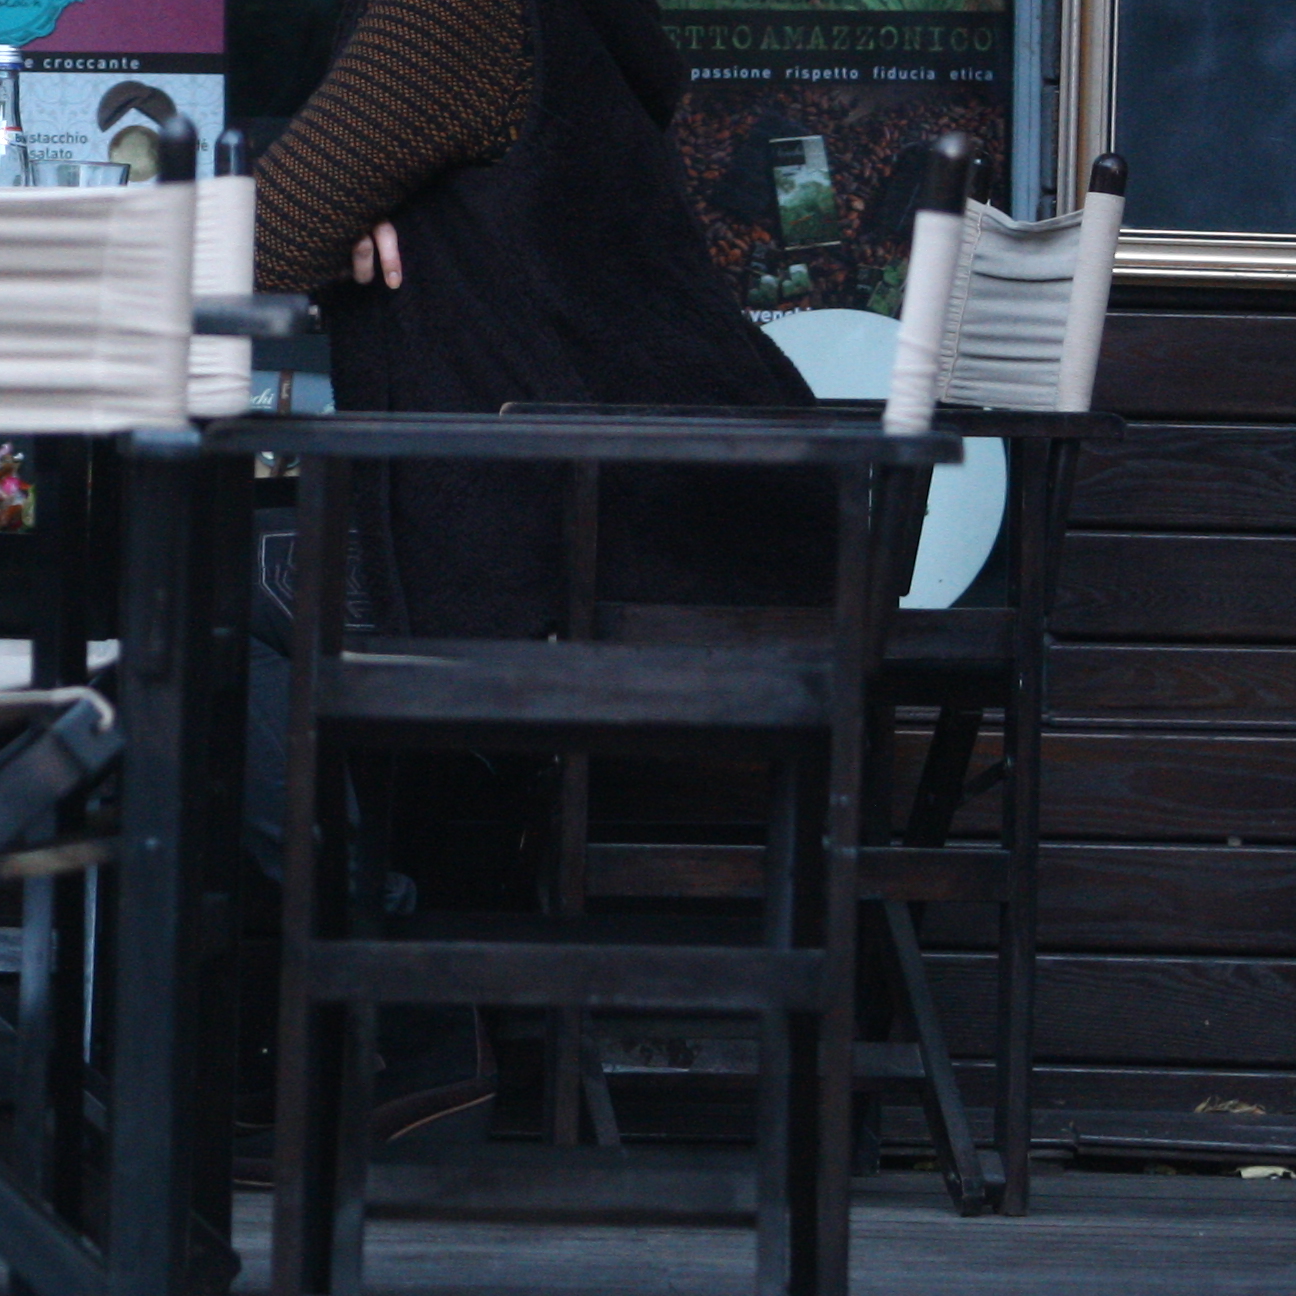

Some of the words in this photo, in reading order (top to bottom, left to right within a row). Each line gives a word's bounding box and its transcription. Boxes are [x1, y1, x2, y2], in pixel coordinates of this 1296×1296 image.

[43, 56, 140, 70] croccante
[690, 65, 772, 82] passione
[784, 65, 859, 83] rispetto
[872, 65, 936, 82] fiducia
[949, 67, 995, 82] etica
[15, 131, 89, 145] stacchio
[29, 146, 73, 160] salato
